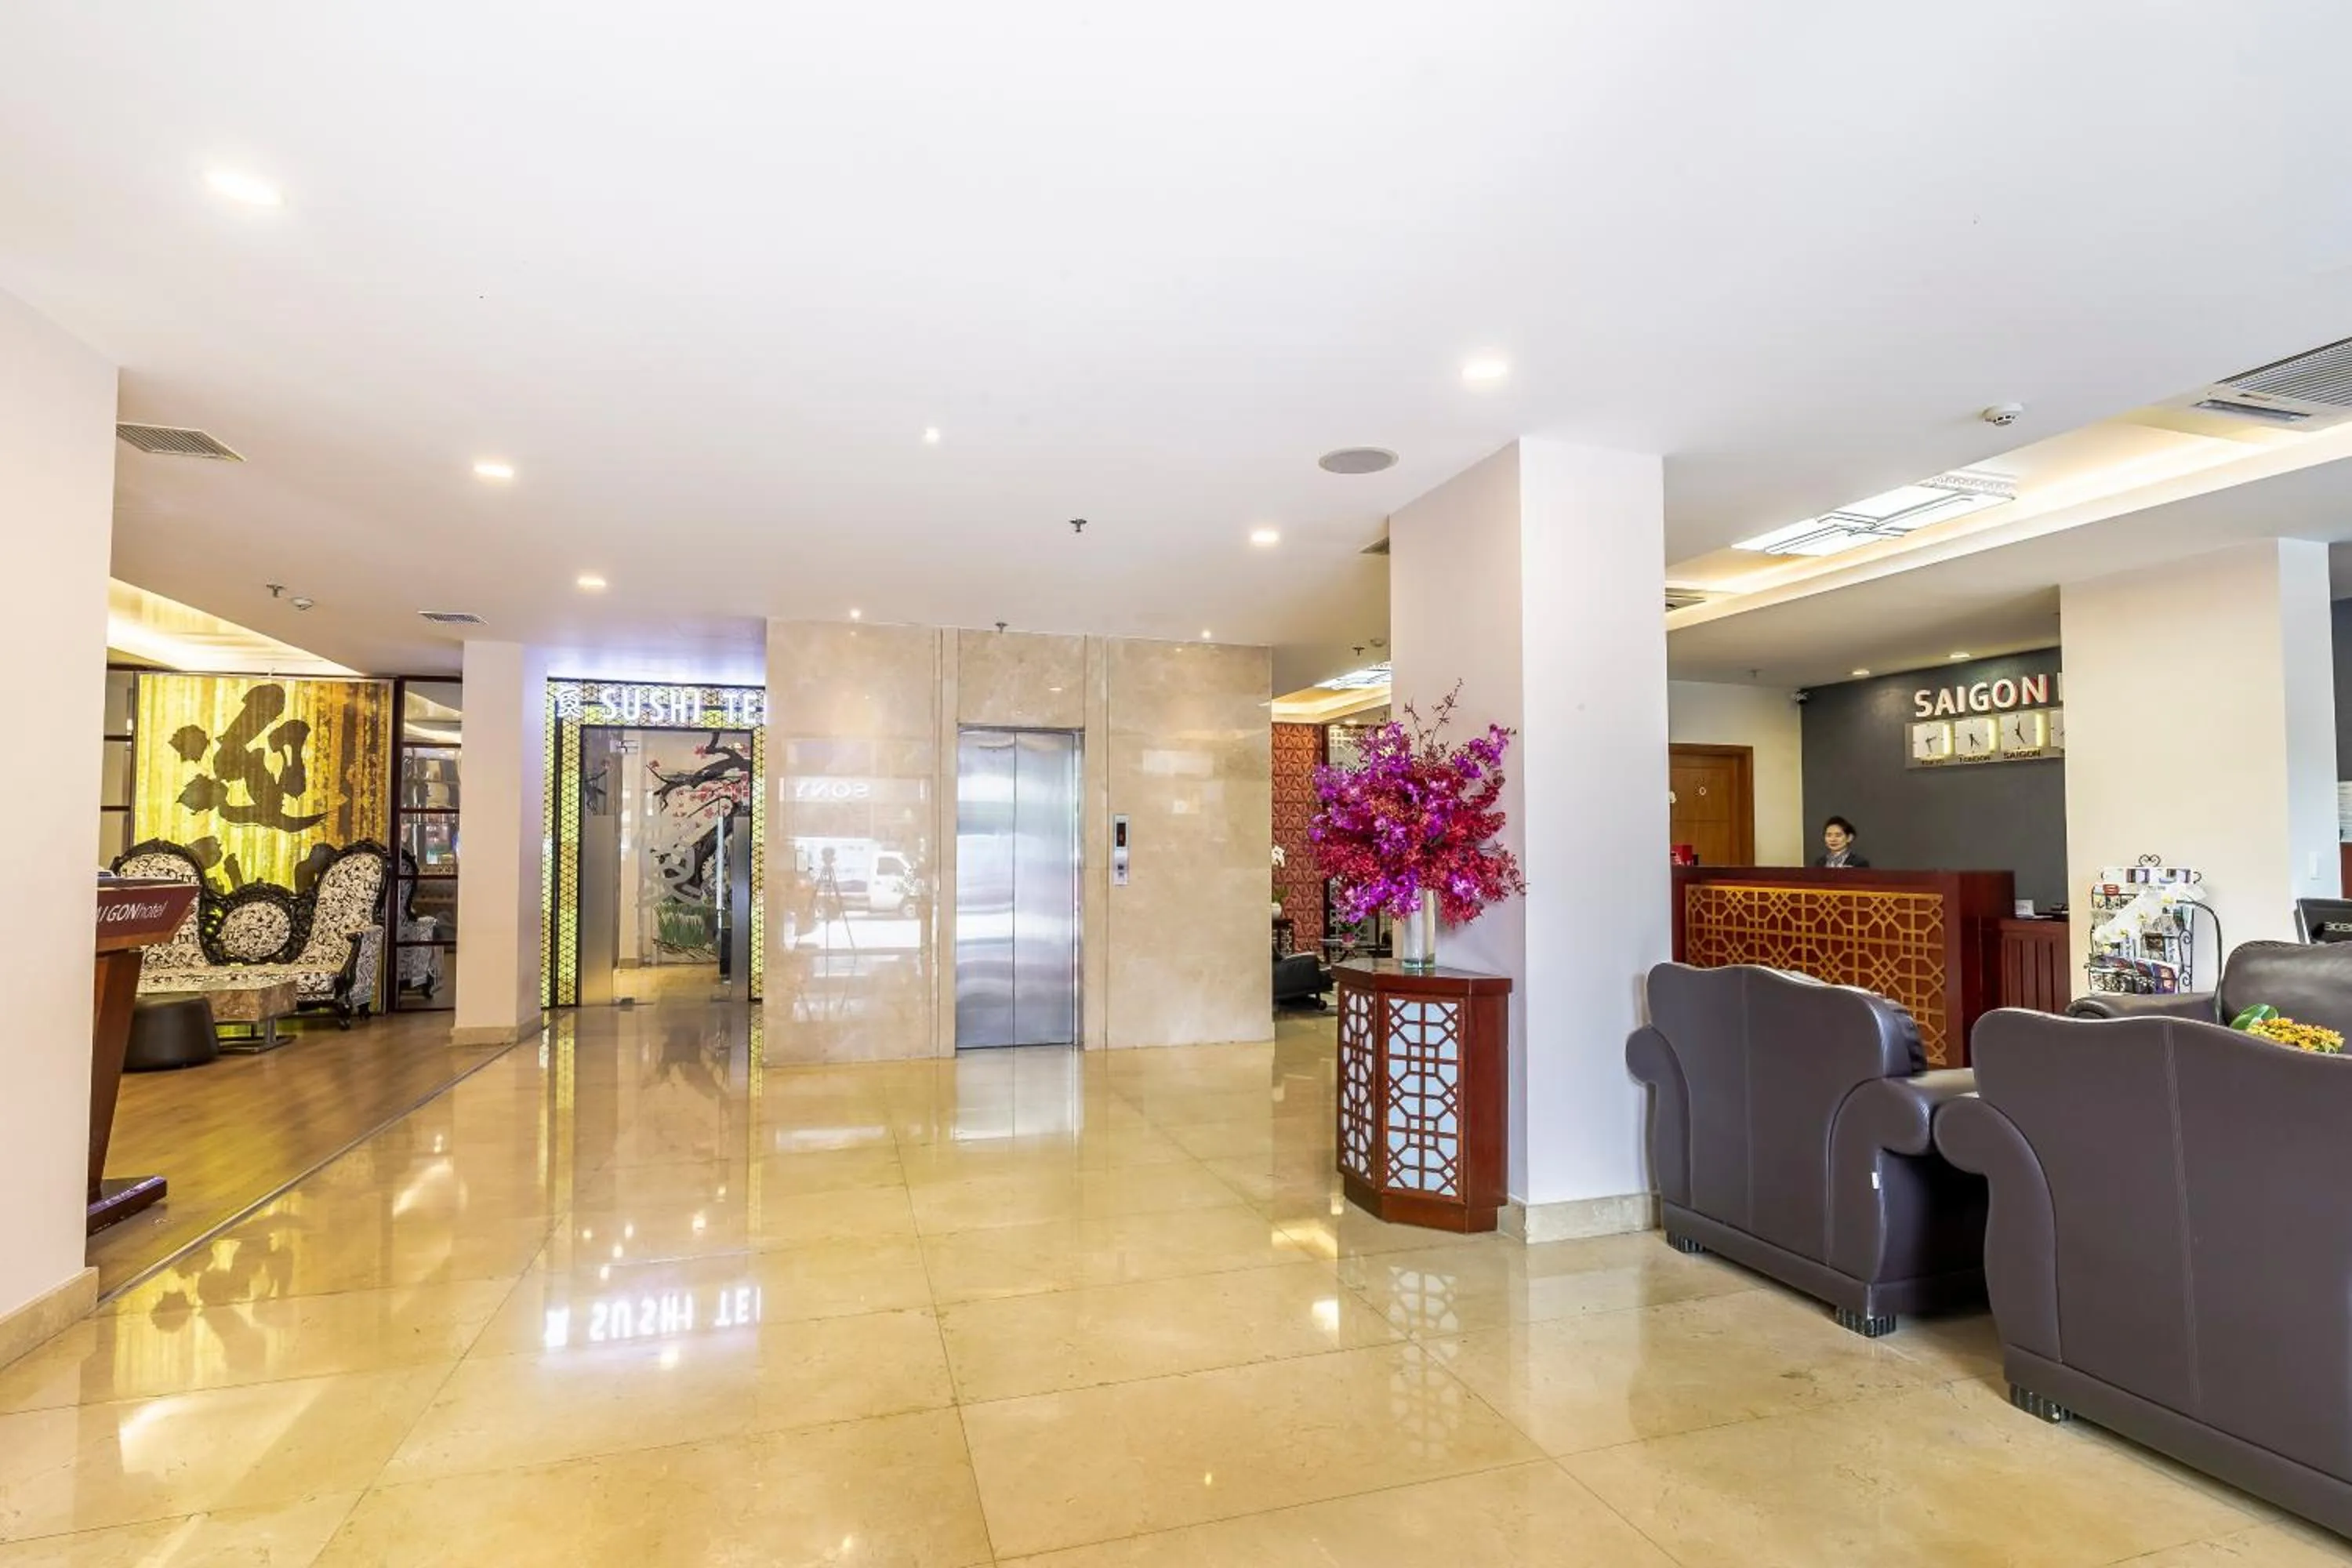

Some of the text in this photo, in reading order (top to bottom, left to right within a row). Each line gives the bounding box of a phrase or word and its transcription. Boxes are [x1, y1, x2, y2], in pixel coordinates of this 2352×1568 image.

[601, 687, 700, 722] SUSHI
[1914, 673, 2049, 717] SAIGON
[2003, 750, 2042, 760] SAIGON
